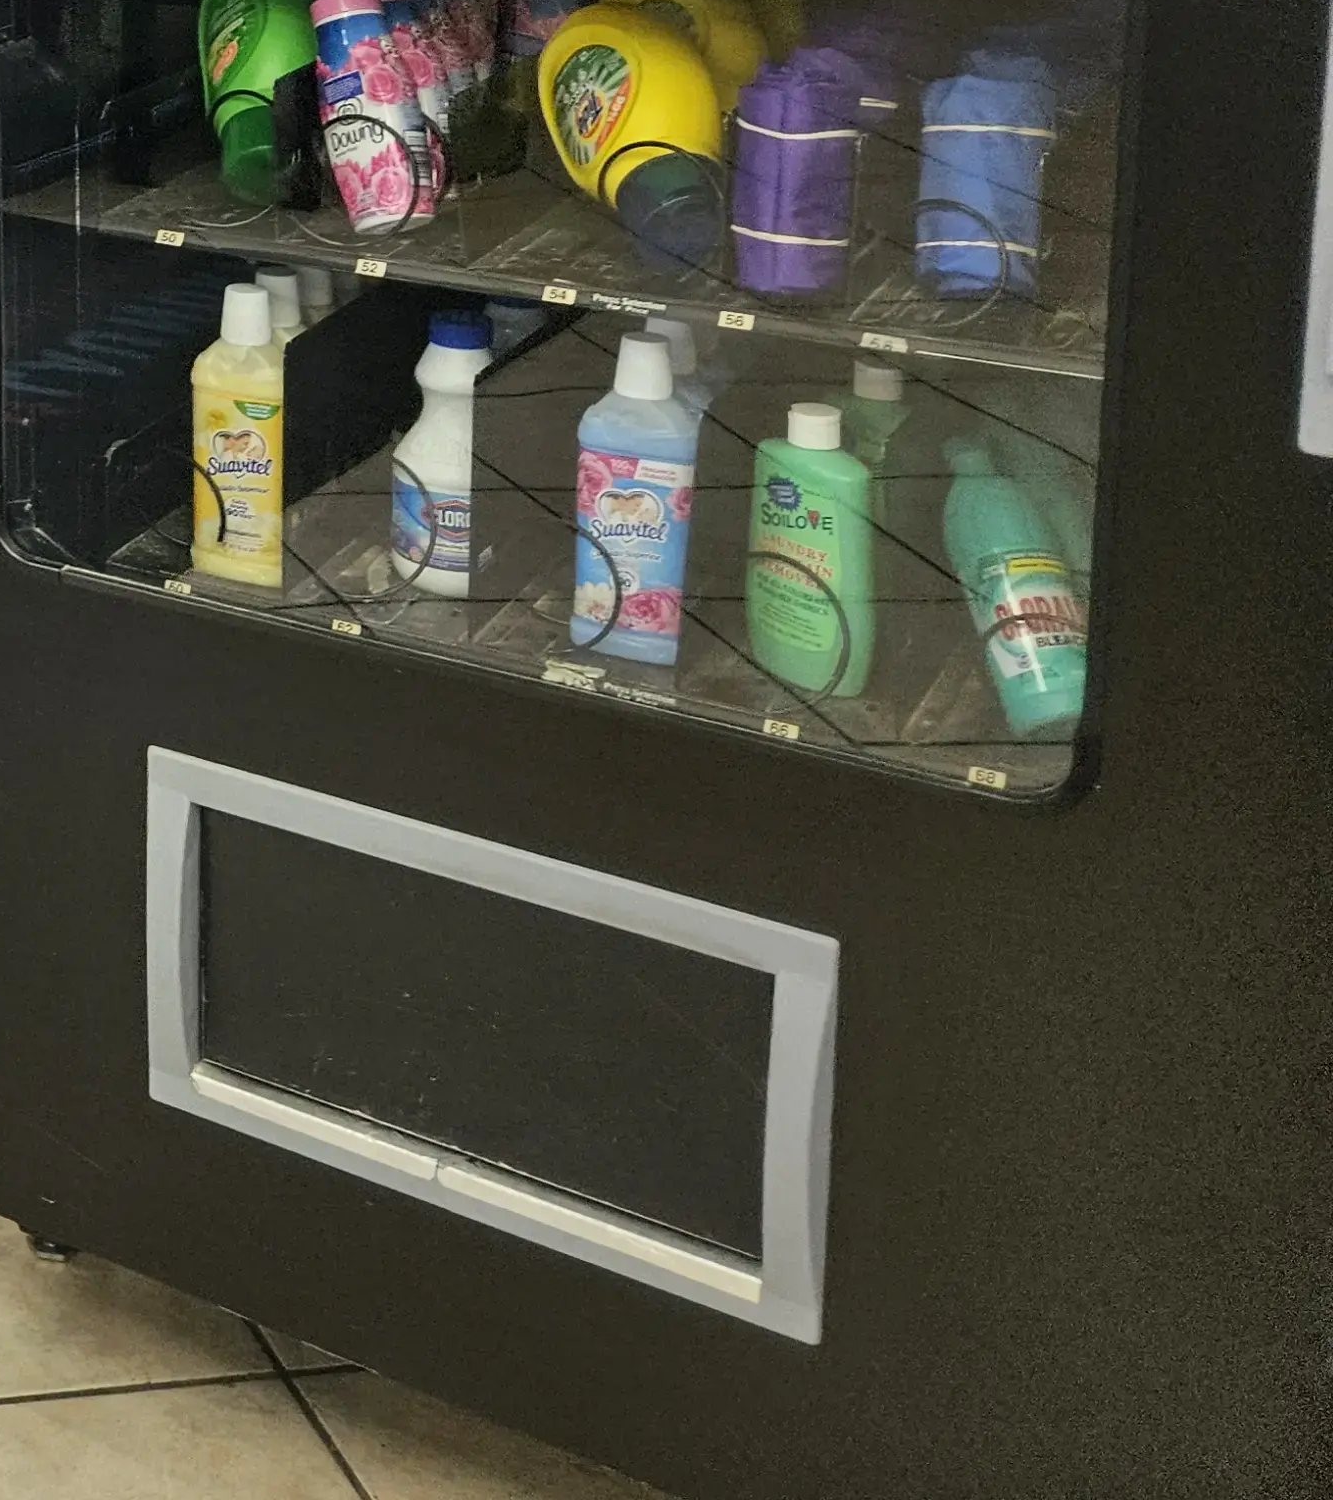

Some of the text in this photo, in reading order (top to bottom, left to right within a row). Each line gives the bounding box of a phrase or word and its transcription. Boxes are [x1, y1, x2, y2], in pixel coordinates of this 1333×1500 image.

[330, 122, 385, 152] Downy
[160, 233, 177, 243] 50
[362, 263, 378, 273] 52
[549, 289, 567, 300] 54
[207, 457, 273, 477] Suavitel
[591, 519, 668, 542] Suavitel
[976, 770, 994, 781] 68
